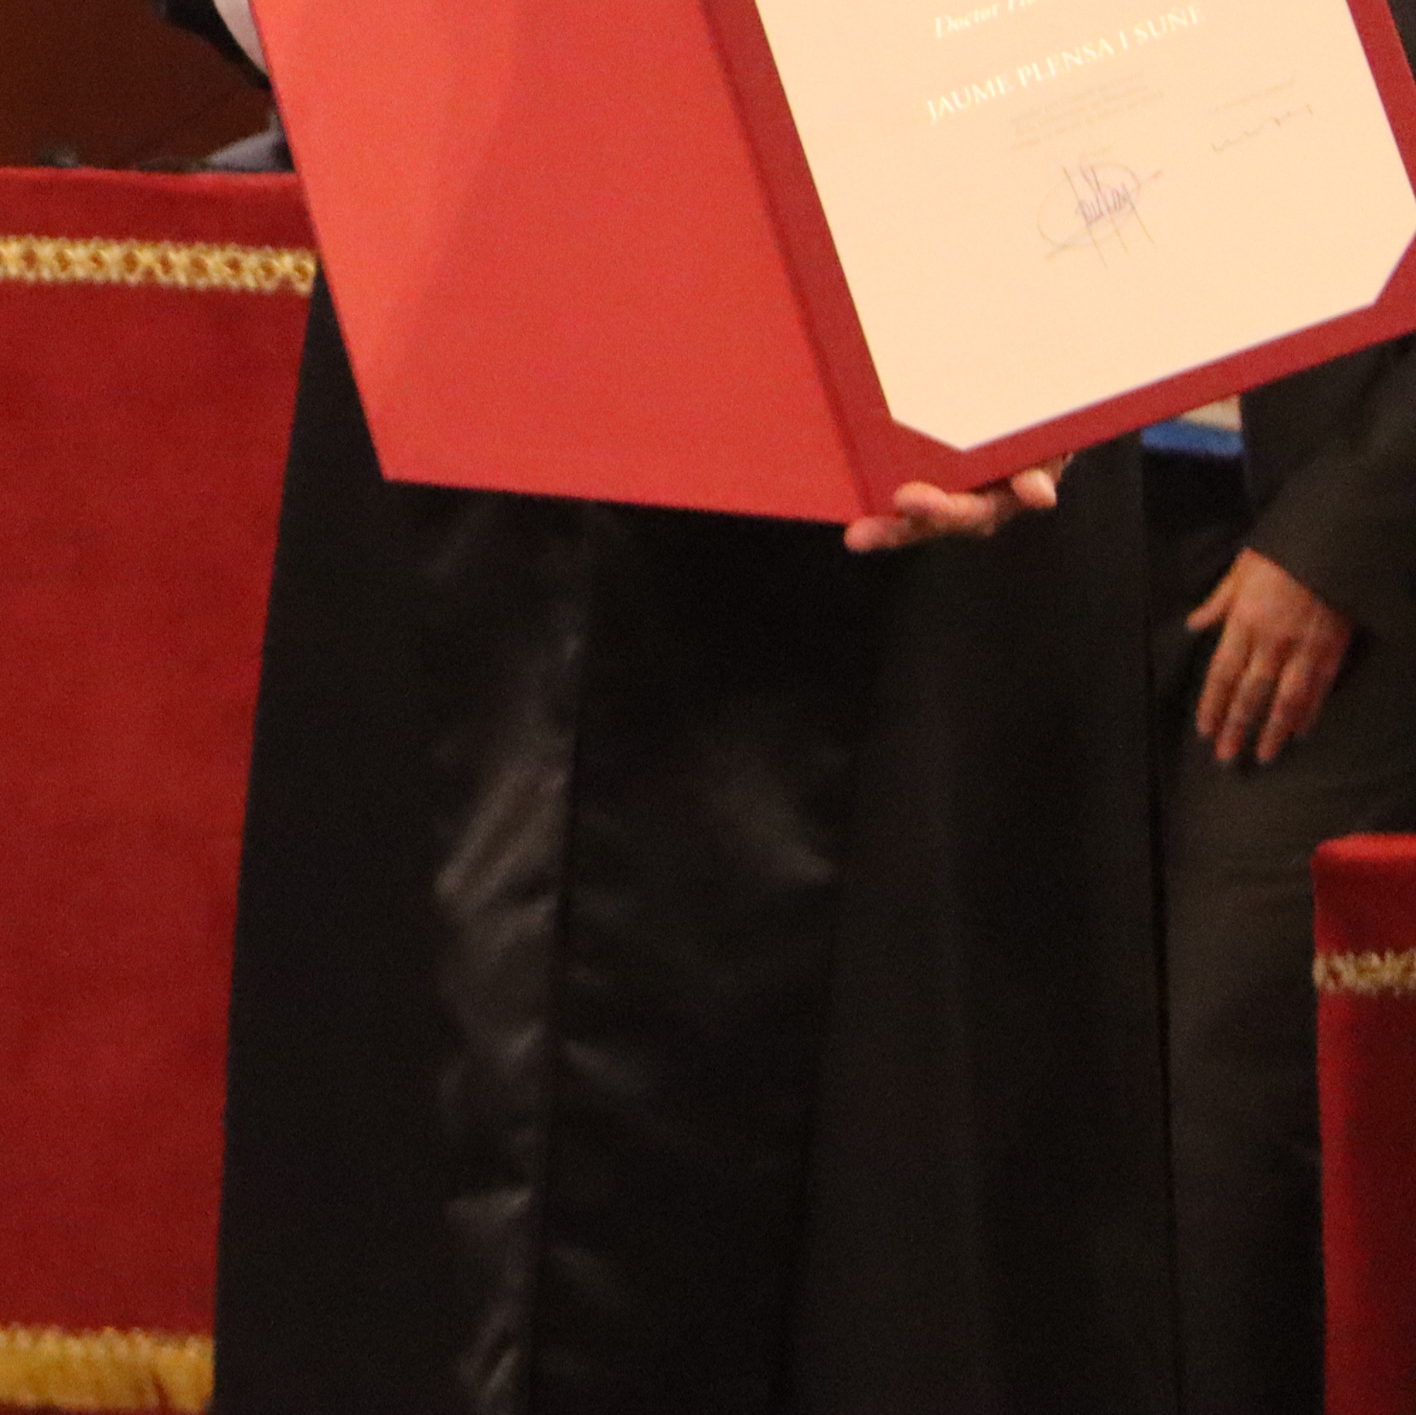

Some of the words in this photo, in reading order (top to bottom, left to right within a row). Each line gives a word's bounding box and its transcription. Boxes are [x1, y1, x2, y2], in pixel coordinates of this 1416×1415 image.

[932, 1, 1000, 41] Doctor
[925, 69, 1013, 126] JAUME
[1016, 37, 1115, 89] PLENSA
[1118, 29, 1130, 51] I
